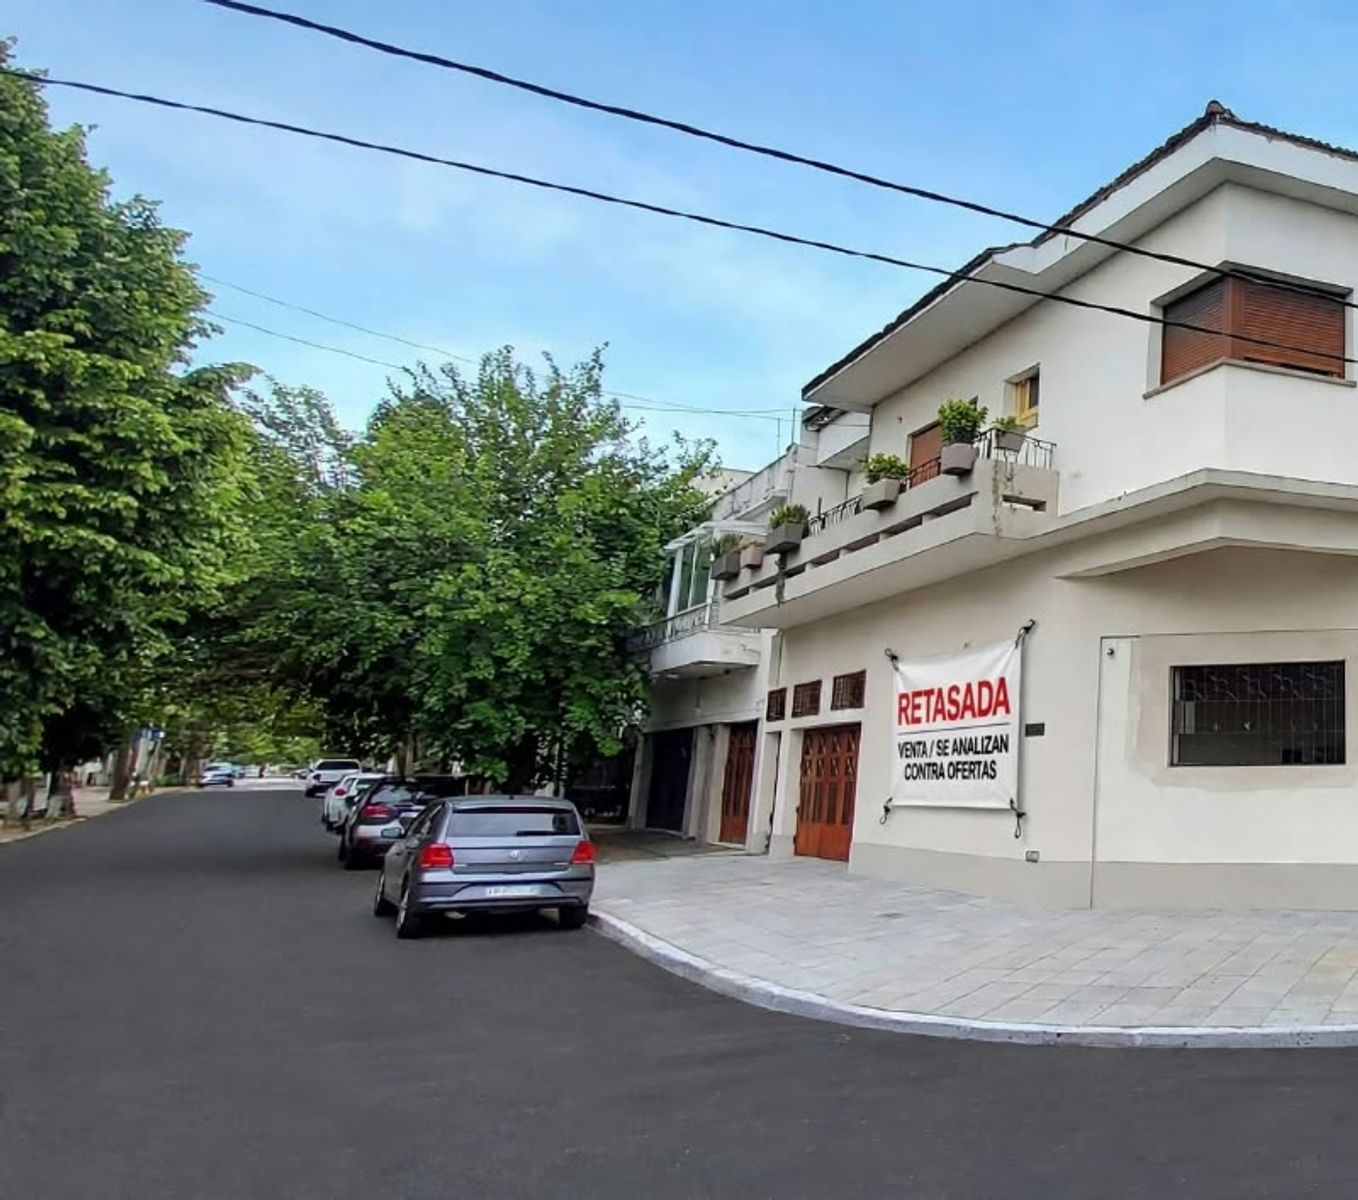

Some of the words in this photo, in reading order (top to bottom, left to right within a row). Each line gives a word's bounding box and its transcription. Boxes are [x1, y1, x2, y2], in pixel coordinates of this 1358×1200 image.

[898, 677, 1010, 725] RETASADA
[898, 740, 928, 758] VENTA
[929, 740, 934, 758] /
[936, 739, 949, 756] SE
[951, 734, 1009, 755] ANALIZAN
[904, 762, 945, 780] CONTRA
[947, 760, 997, 779] OFERTAS
